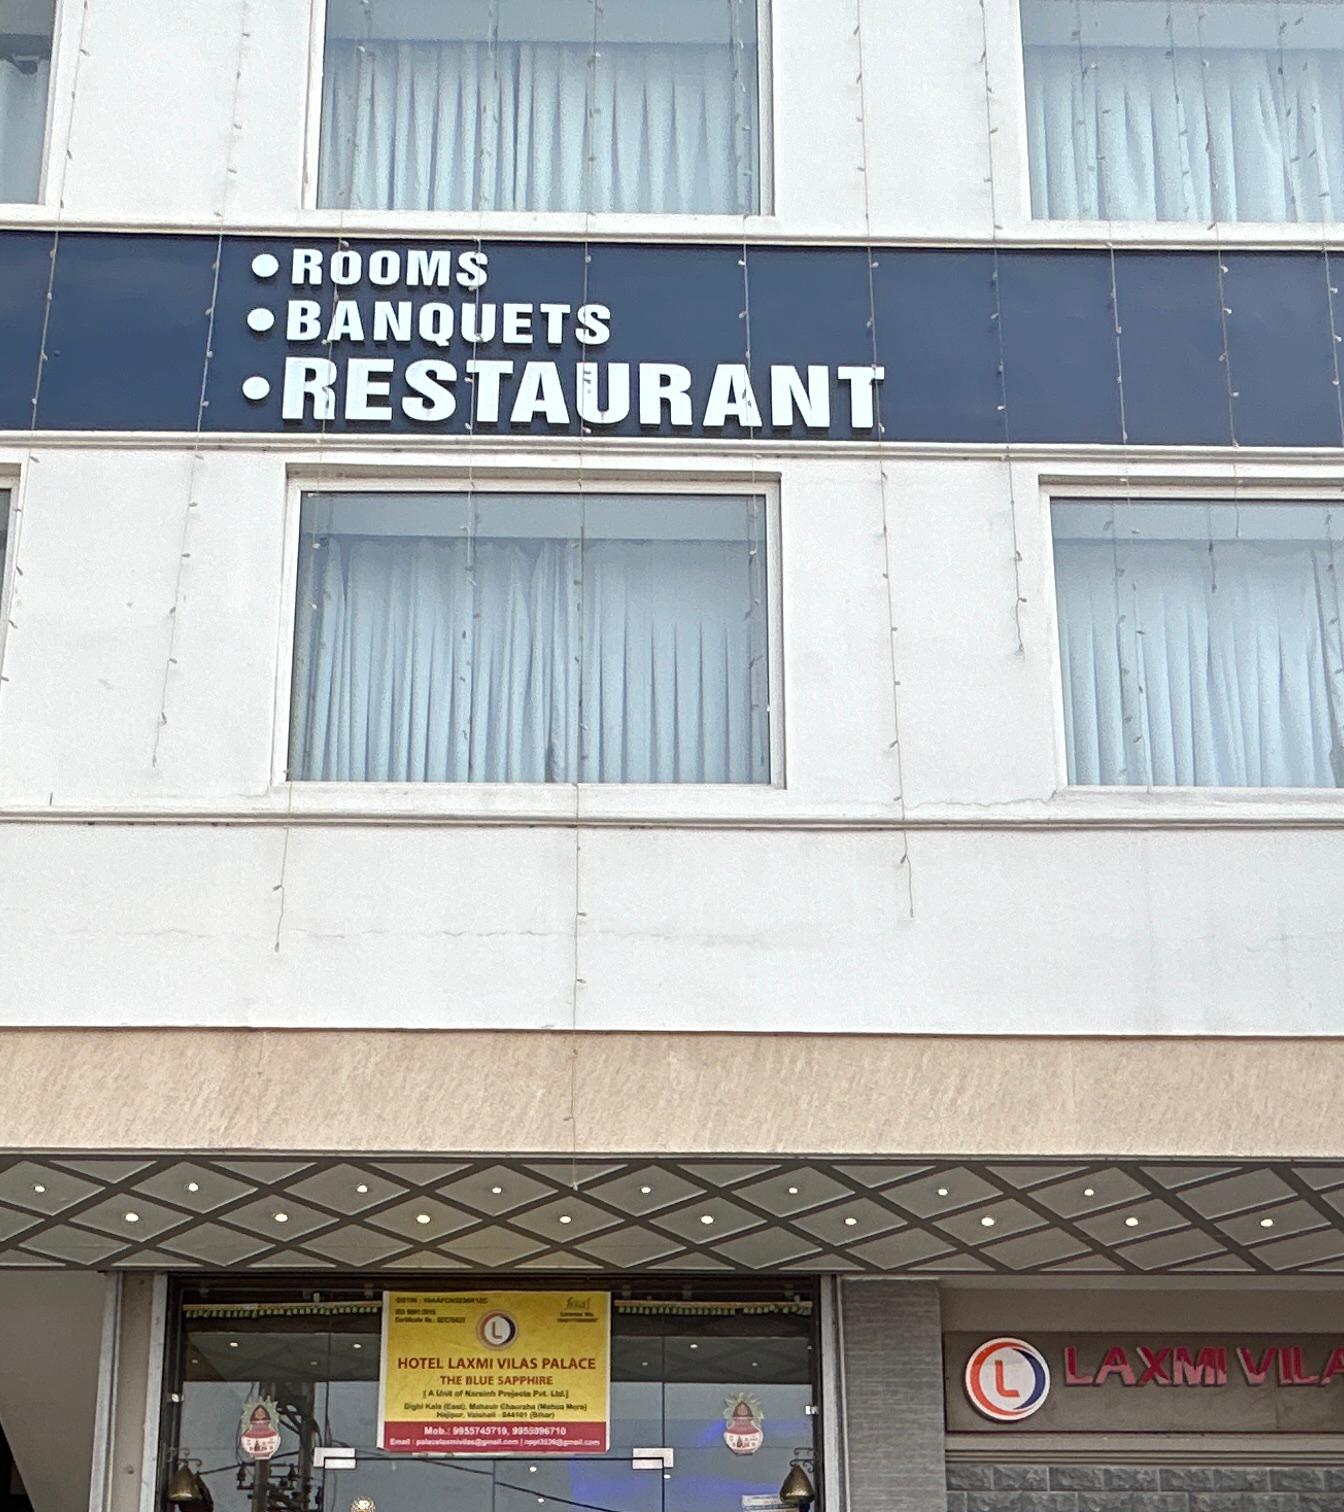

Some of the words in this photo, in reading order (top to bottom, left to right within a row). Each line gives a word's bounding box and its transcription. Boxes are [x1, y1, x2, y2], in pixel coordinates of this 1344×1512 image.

[291, 248, 488, 287] ROOMS
[286, 300, 611, 346] BANQUETS
[280, 357, 884, 429] RESTAURANT
[398, 1357, 444, 1369] HOTEL
[448, 1357, 494, 1370] LAXMI
[497, 1358, 538, 1370] VILAS
[542, 1358, 596, 1370] PALACE
[440, 1375, 463, 1385] THE
[465, 1375, 495, 1385] BLUE
[497, 1375, 554, 1385] SAPPHIRE
[1064, 1345, 1227, 1386] LAXMI
